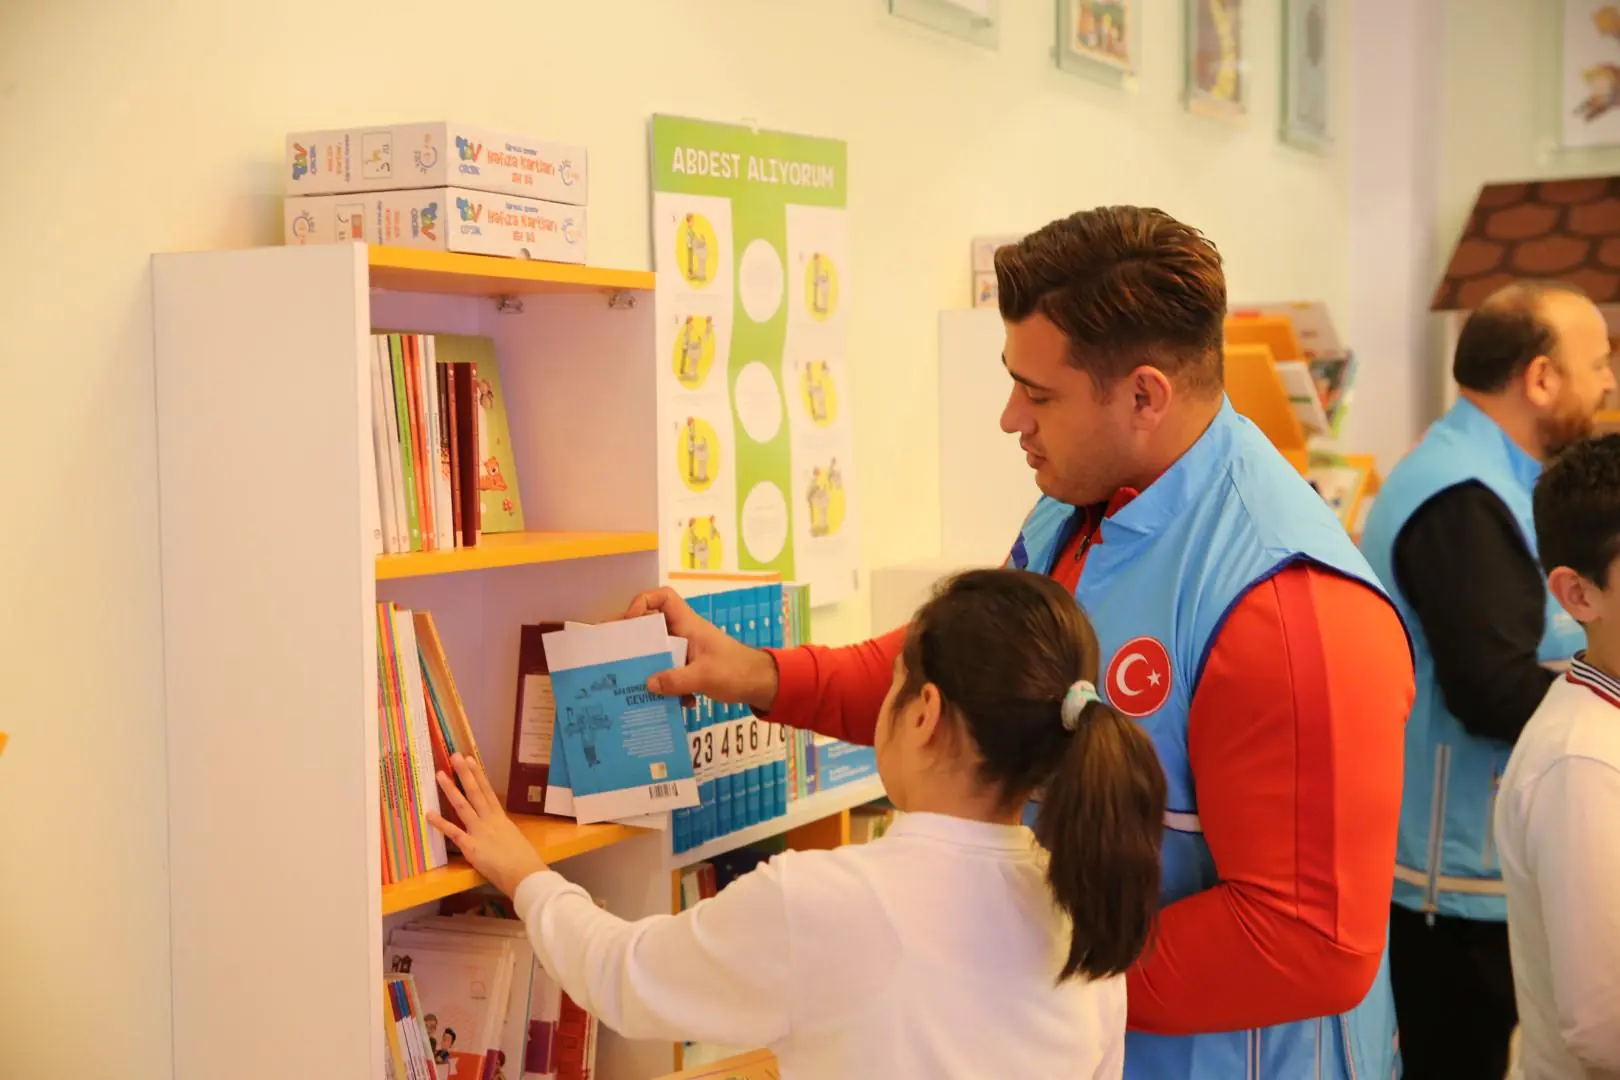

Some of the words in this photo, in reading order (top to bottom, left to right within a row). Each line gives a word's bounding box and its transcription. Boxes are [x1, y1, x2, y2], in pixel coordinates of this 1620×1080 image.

[671, 146, 741, 178] ABDEST
[747, 155, 835, 188] ALIYORUM
[704, 732, 713, 764] 3
[720, 727, 730, 758] 4
[735, 724, 744, 755] 5
[749, 720, 758, 750] 6
[692, 736, 702, 769] 2
